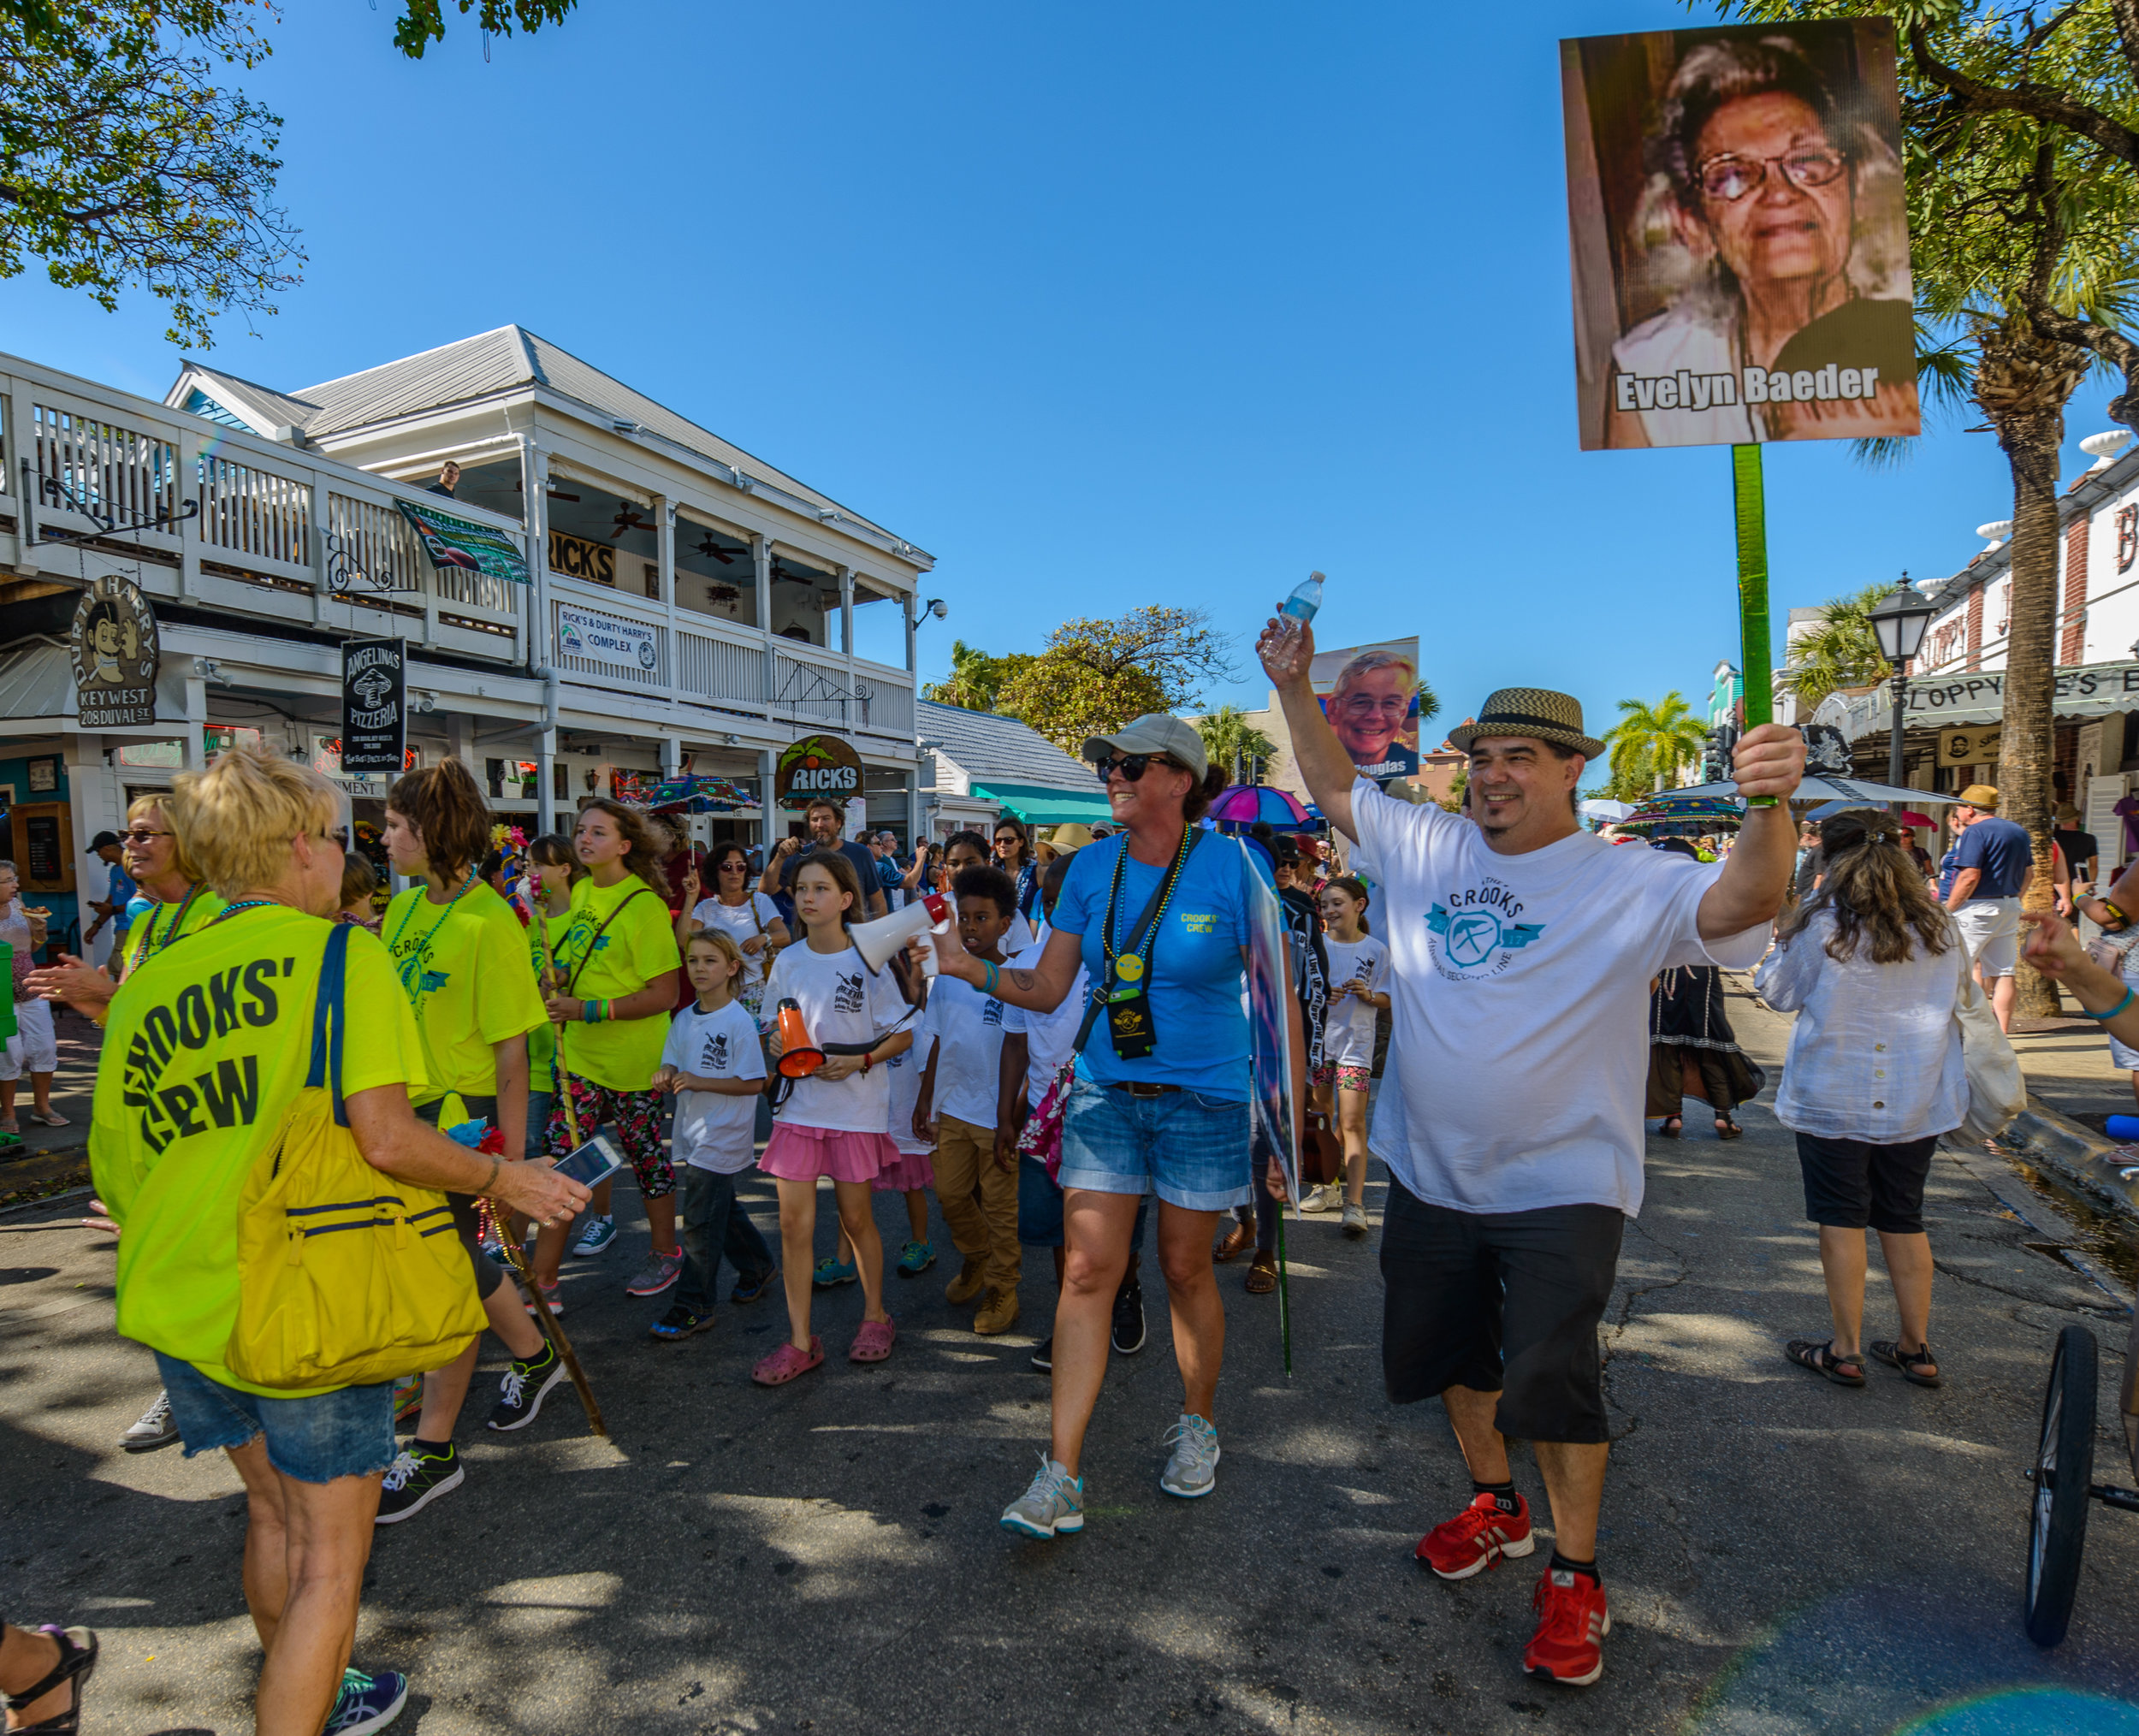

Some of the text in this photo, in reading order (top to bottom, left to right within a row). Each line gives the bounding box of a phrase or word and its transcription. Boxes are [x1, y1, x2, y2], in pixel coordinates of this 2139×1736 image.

[1615, 363, 1880, 412] Evelyn Baeder
[72, 577, 155, 687] DURTY HARRY'S
[562, 611, 653, 641] RICK'S & DURTY HARRY'S
[588, 634, 632, 653] COMPLEX
[346, 647, 400, 684] ANGELINA'S
[80, 688, 147, 706] KEY WEST
[2053, 672, 2097, 697] E'S
[80, 710, 100, 726] 208
[100, 708, 137, 725] DUVAL
[350, 700, 399, 730] PIZZERIA
[791, 766, 857, 790] RICK'S
[1449, 887, 1525, 918] CROOKS
[1187, 923, 1213, 933] CREW
[1508, 935, 1523, 945] 17
[393, 938, 434, 964] CROOKS
[1491, 951, 1513, 975] LINE
